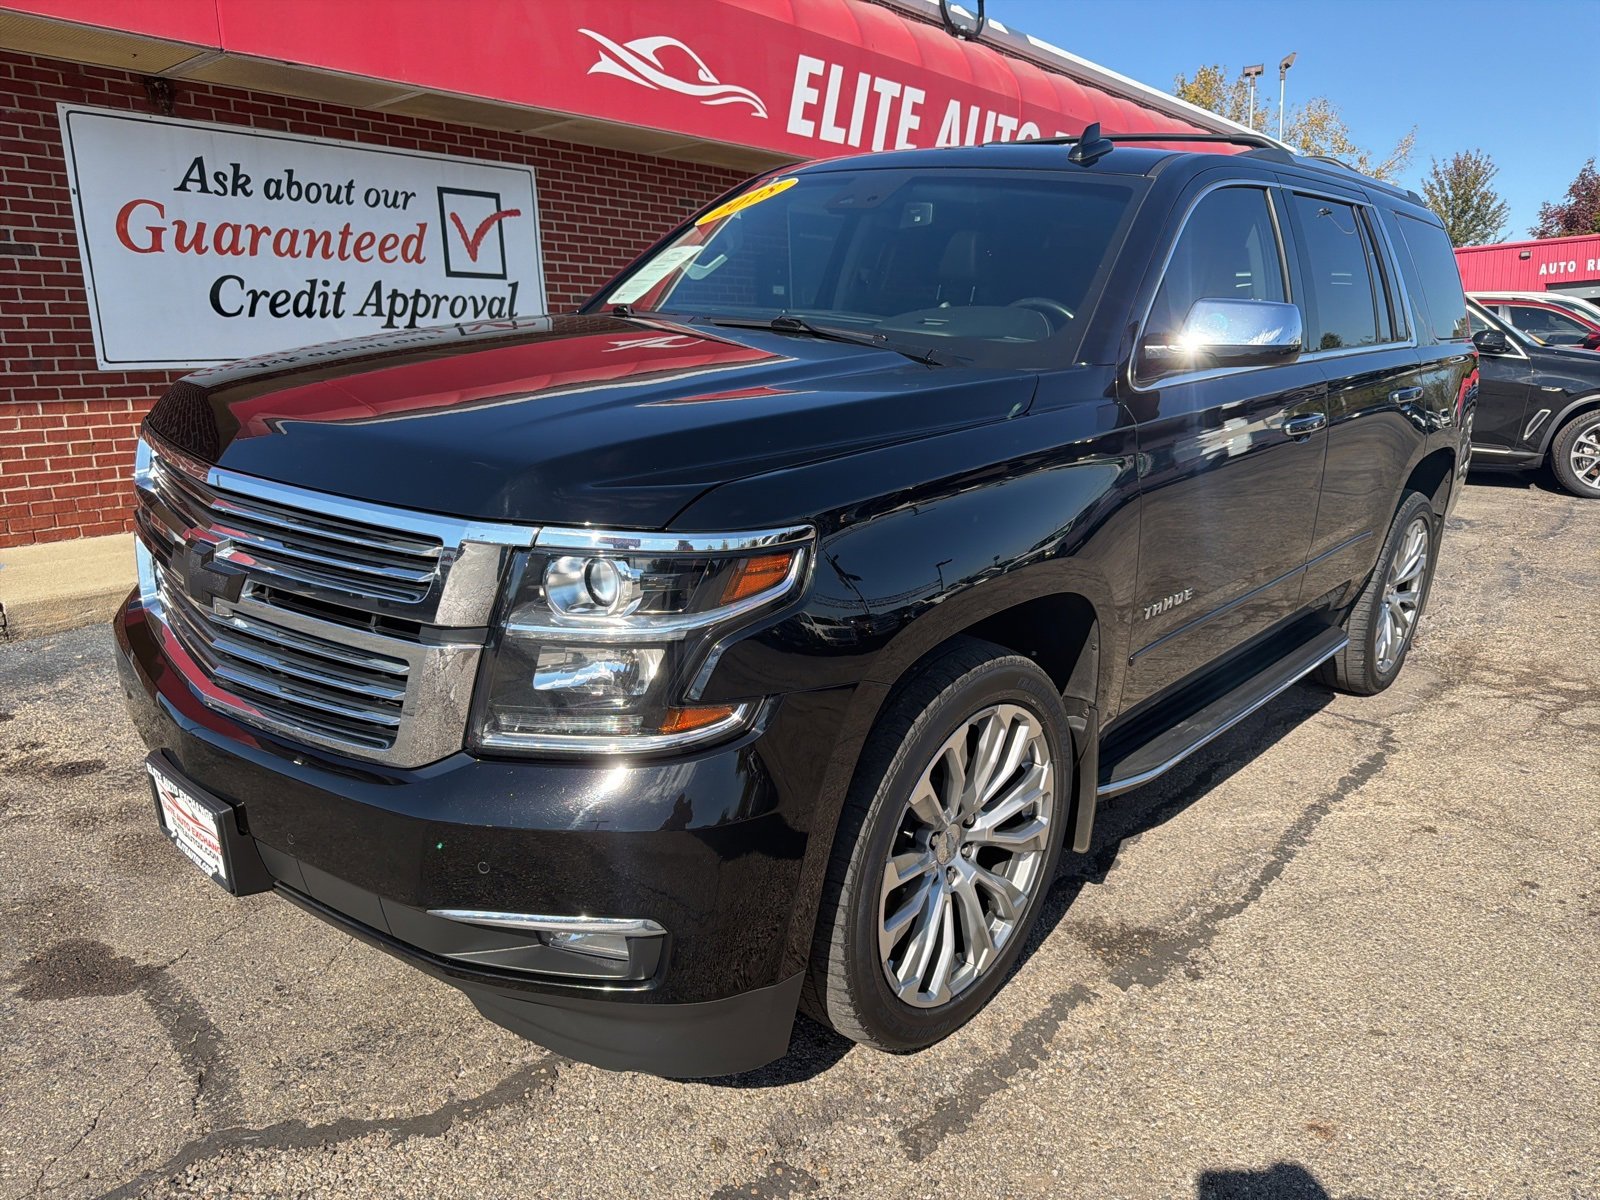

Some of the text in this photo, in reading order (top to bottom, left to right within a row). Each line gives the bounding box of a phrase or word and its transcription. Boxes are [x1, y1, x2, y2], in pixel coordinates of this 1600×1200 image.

[786, 53, 927, 151] ELITE
[173, 156, 417, 211] Ask about our
[114, 198, 428, 265] Guaranteed
[1538, 260, 1577, 276] AUTO
[208, 274, 520, 329] Credit Approval
[1143, 587, 1194, 621] TAHOE
